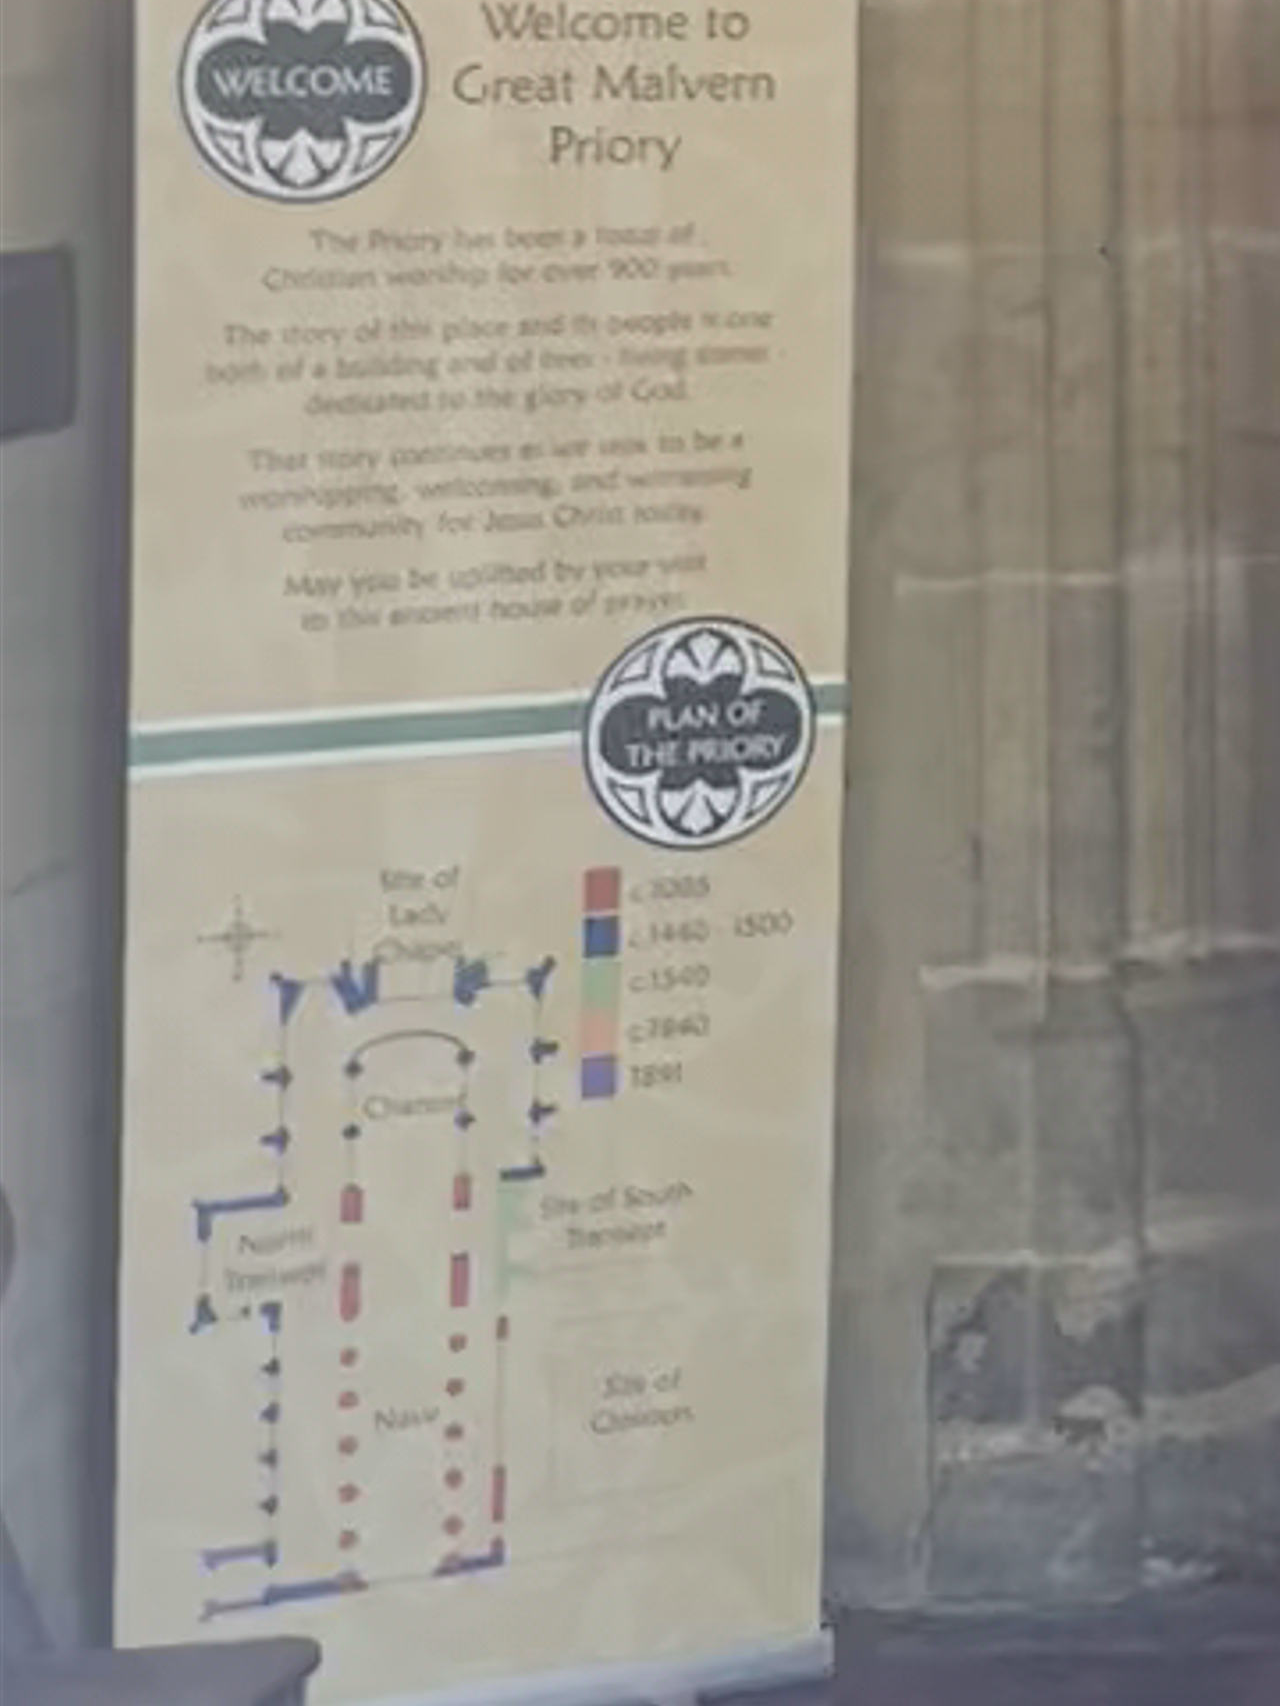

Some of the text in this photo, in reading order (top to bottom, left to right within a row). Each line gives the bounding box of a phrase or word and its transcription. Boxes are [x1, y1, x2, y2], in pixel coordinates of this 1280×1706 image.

[481, 1, 751, 42] Welcome to
[211, 65, 393, 99] WELCOME
[453, 62, 775, 105] Great Malvern
[550, 126, 682, 172] Priory
[308, 226, 358, 253] The
[224, 324, 270, 346] The
[648, 698, 766, 732] PLAN OF
[625, 733, 787, 767] THE PRIORY
